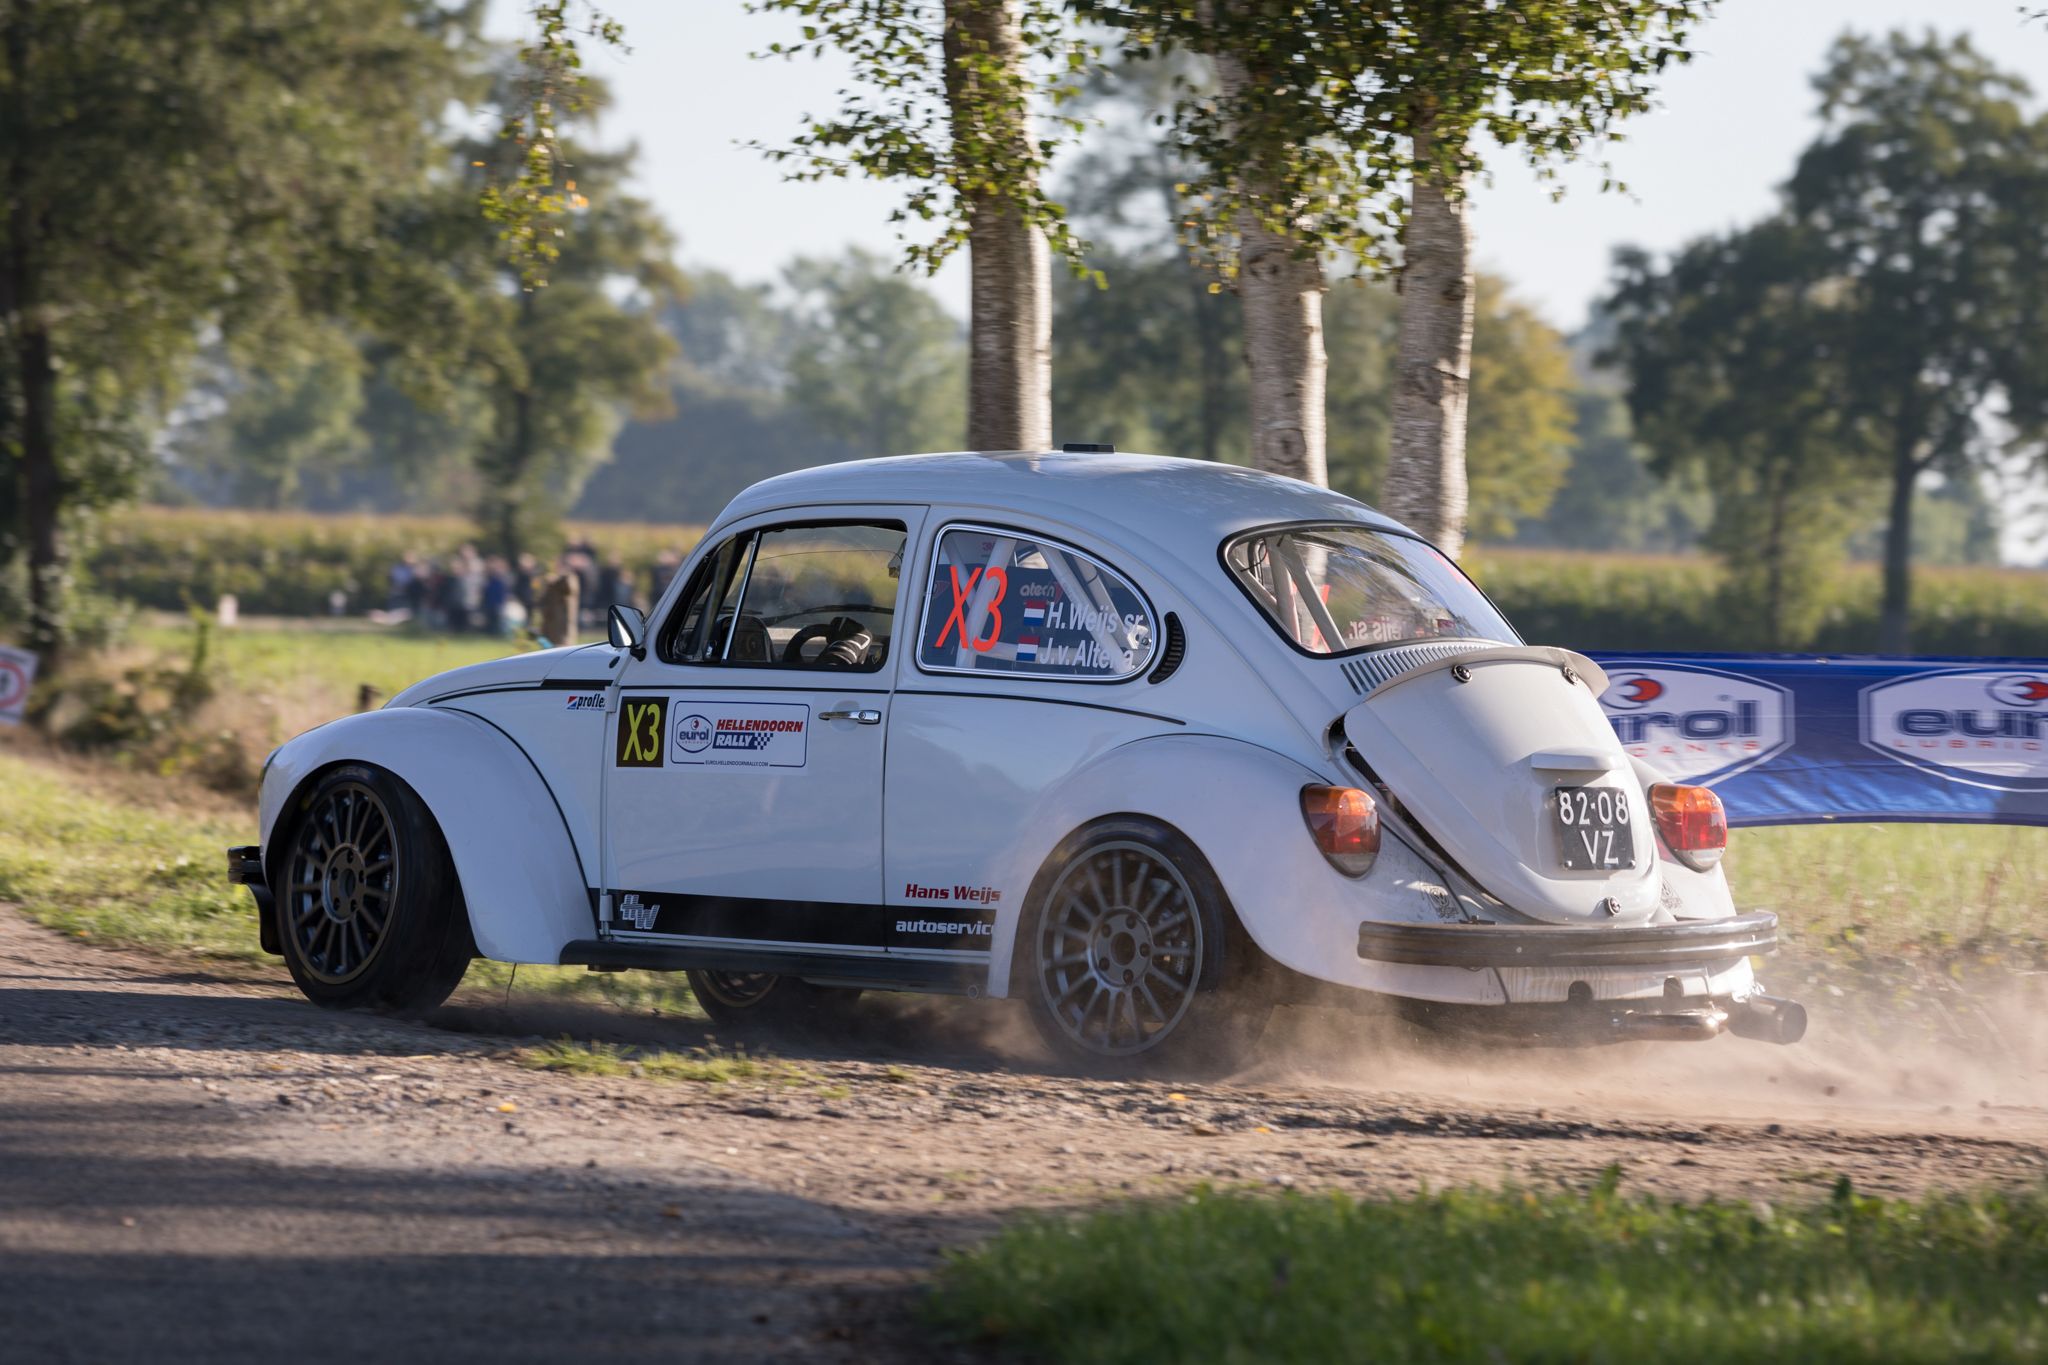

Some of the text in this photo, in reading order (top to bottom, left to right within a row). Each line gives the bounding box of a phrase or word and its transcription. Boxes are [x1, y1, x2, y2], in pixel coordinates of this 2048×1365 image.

[934, 566, 1008, 652] X3
[577, 694, 606, 709] profle
[716, 719, 803, 733] HELLENDOORN
[1607, 700, 1762, 744] rol
[1893, 709, 2048, 739] eur
[622, 703, 661, 762] X3
[679, 728, 709, 740] eurol
[715, 734, 754, 747] RALLY
[1893, 739, 2041, 751] LUBRIC
[1580, 830, 1619, 864] VZ
[905, 883, 1002, 905] Hans Weijs
[895, 920, 994, 936] autoservic
